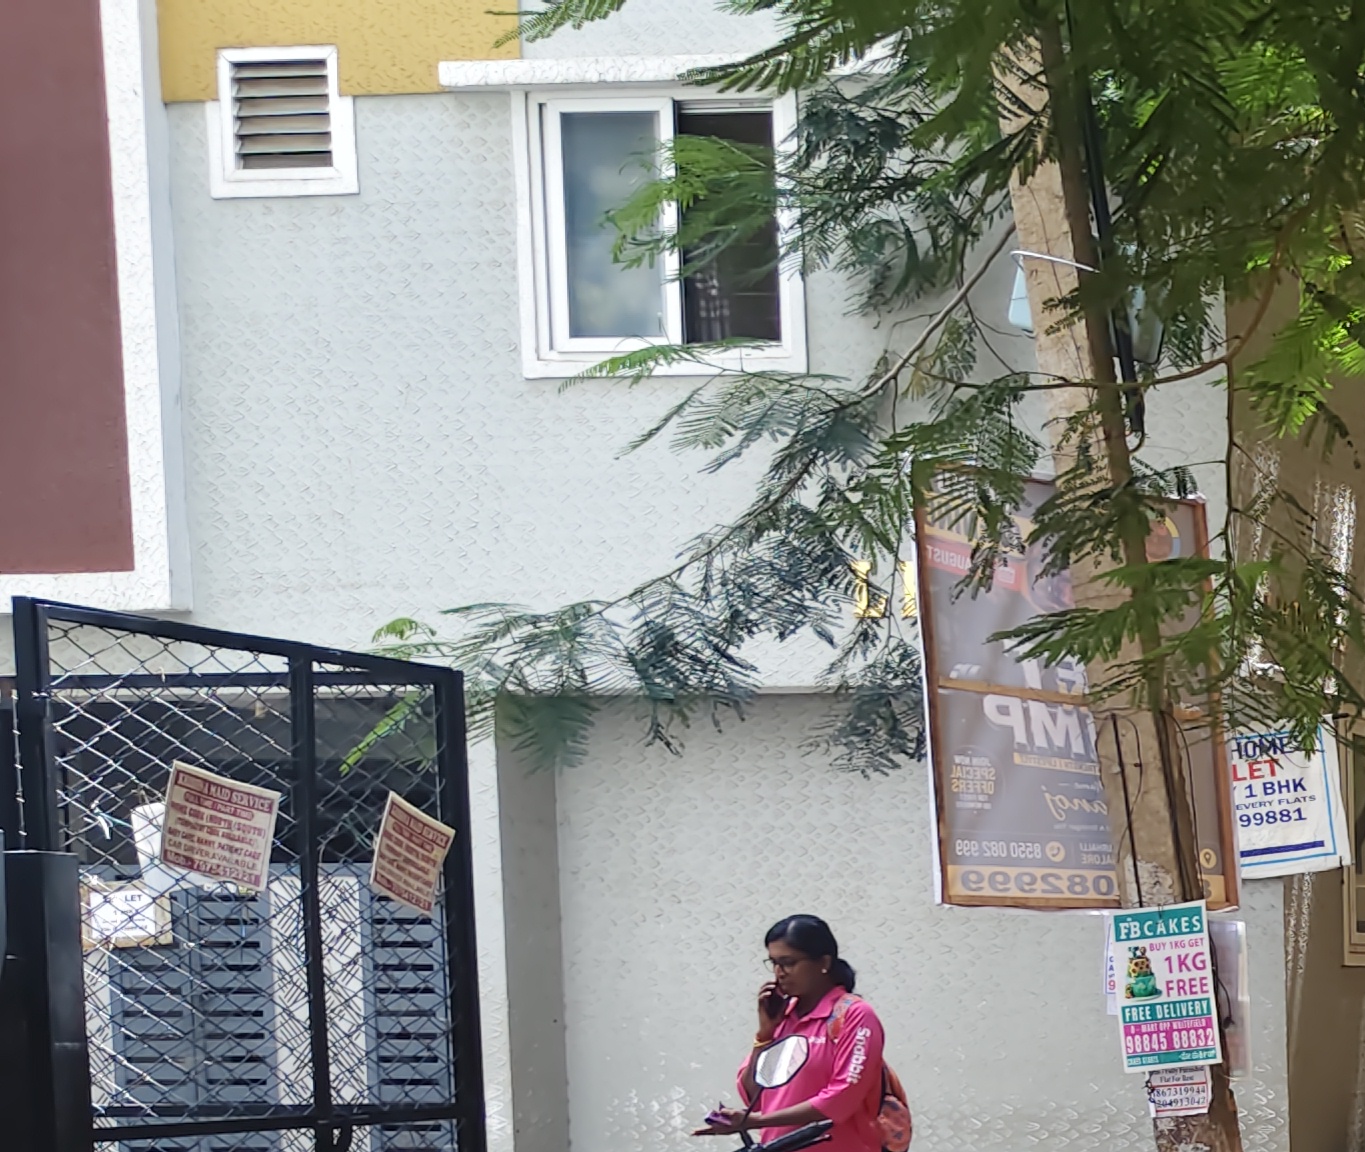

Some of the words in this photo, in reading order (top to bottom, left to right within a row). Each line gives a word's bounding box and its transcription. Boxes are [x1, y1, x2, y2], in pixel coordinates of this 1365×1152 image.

[1232, 758, 1280, 782] LET
[1244, 783, 1258, 799] 1
[1262, 777, 1307, 797] BHK
[231, 790, 273, 812] SERVICE
[1235, 799, 1275, 811] EVERY
[1277, 794, 1317, 806] FLATS
[1238, 807, 1308, 828] 99881
[1143, 915, 1202, 936] CAKES
[1149, 941, 1167, 952] BUY
[1169, 940, 1186, 950] 1KG
[1188, 937, 1205, 948] GET
[1164, 951, 1207, 974] 1KG
[1165, 976, 1210, 998] FREE
[1124, 1005, 1152, 1022] FREE
[1156, 1000, 1209, 1020] DELIVERY
[1126, 1032, 1168, 1054] 98845
[1172, 1027, 1215, 1049] 88832
[846, 1026, 872, 1085] Snabbit
